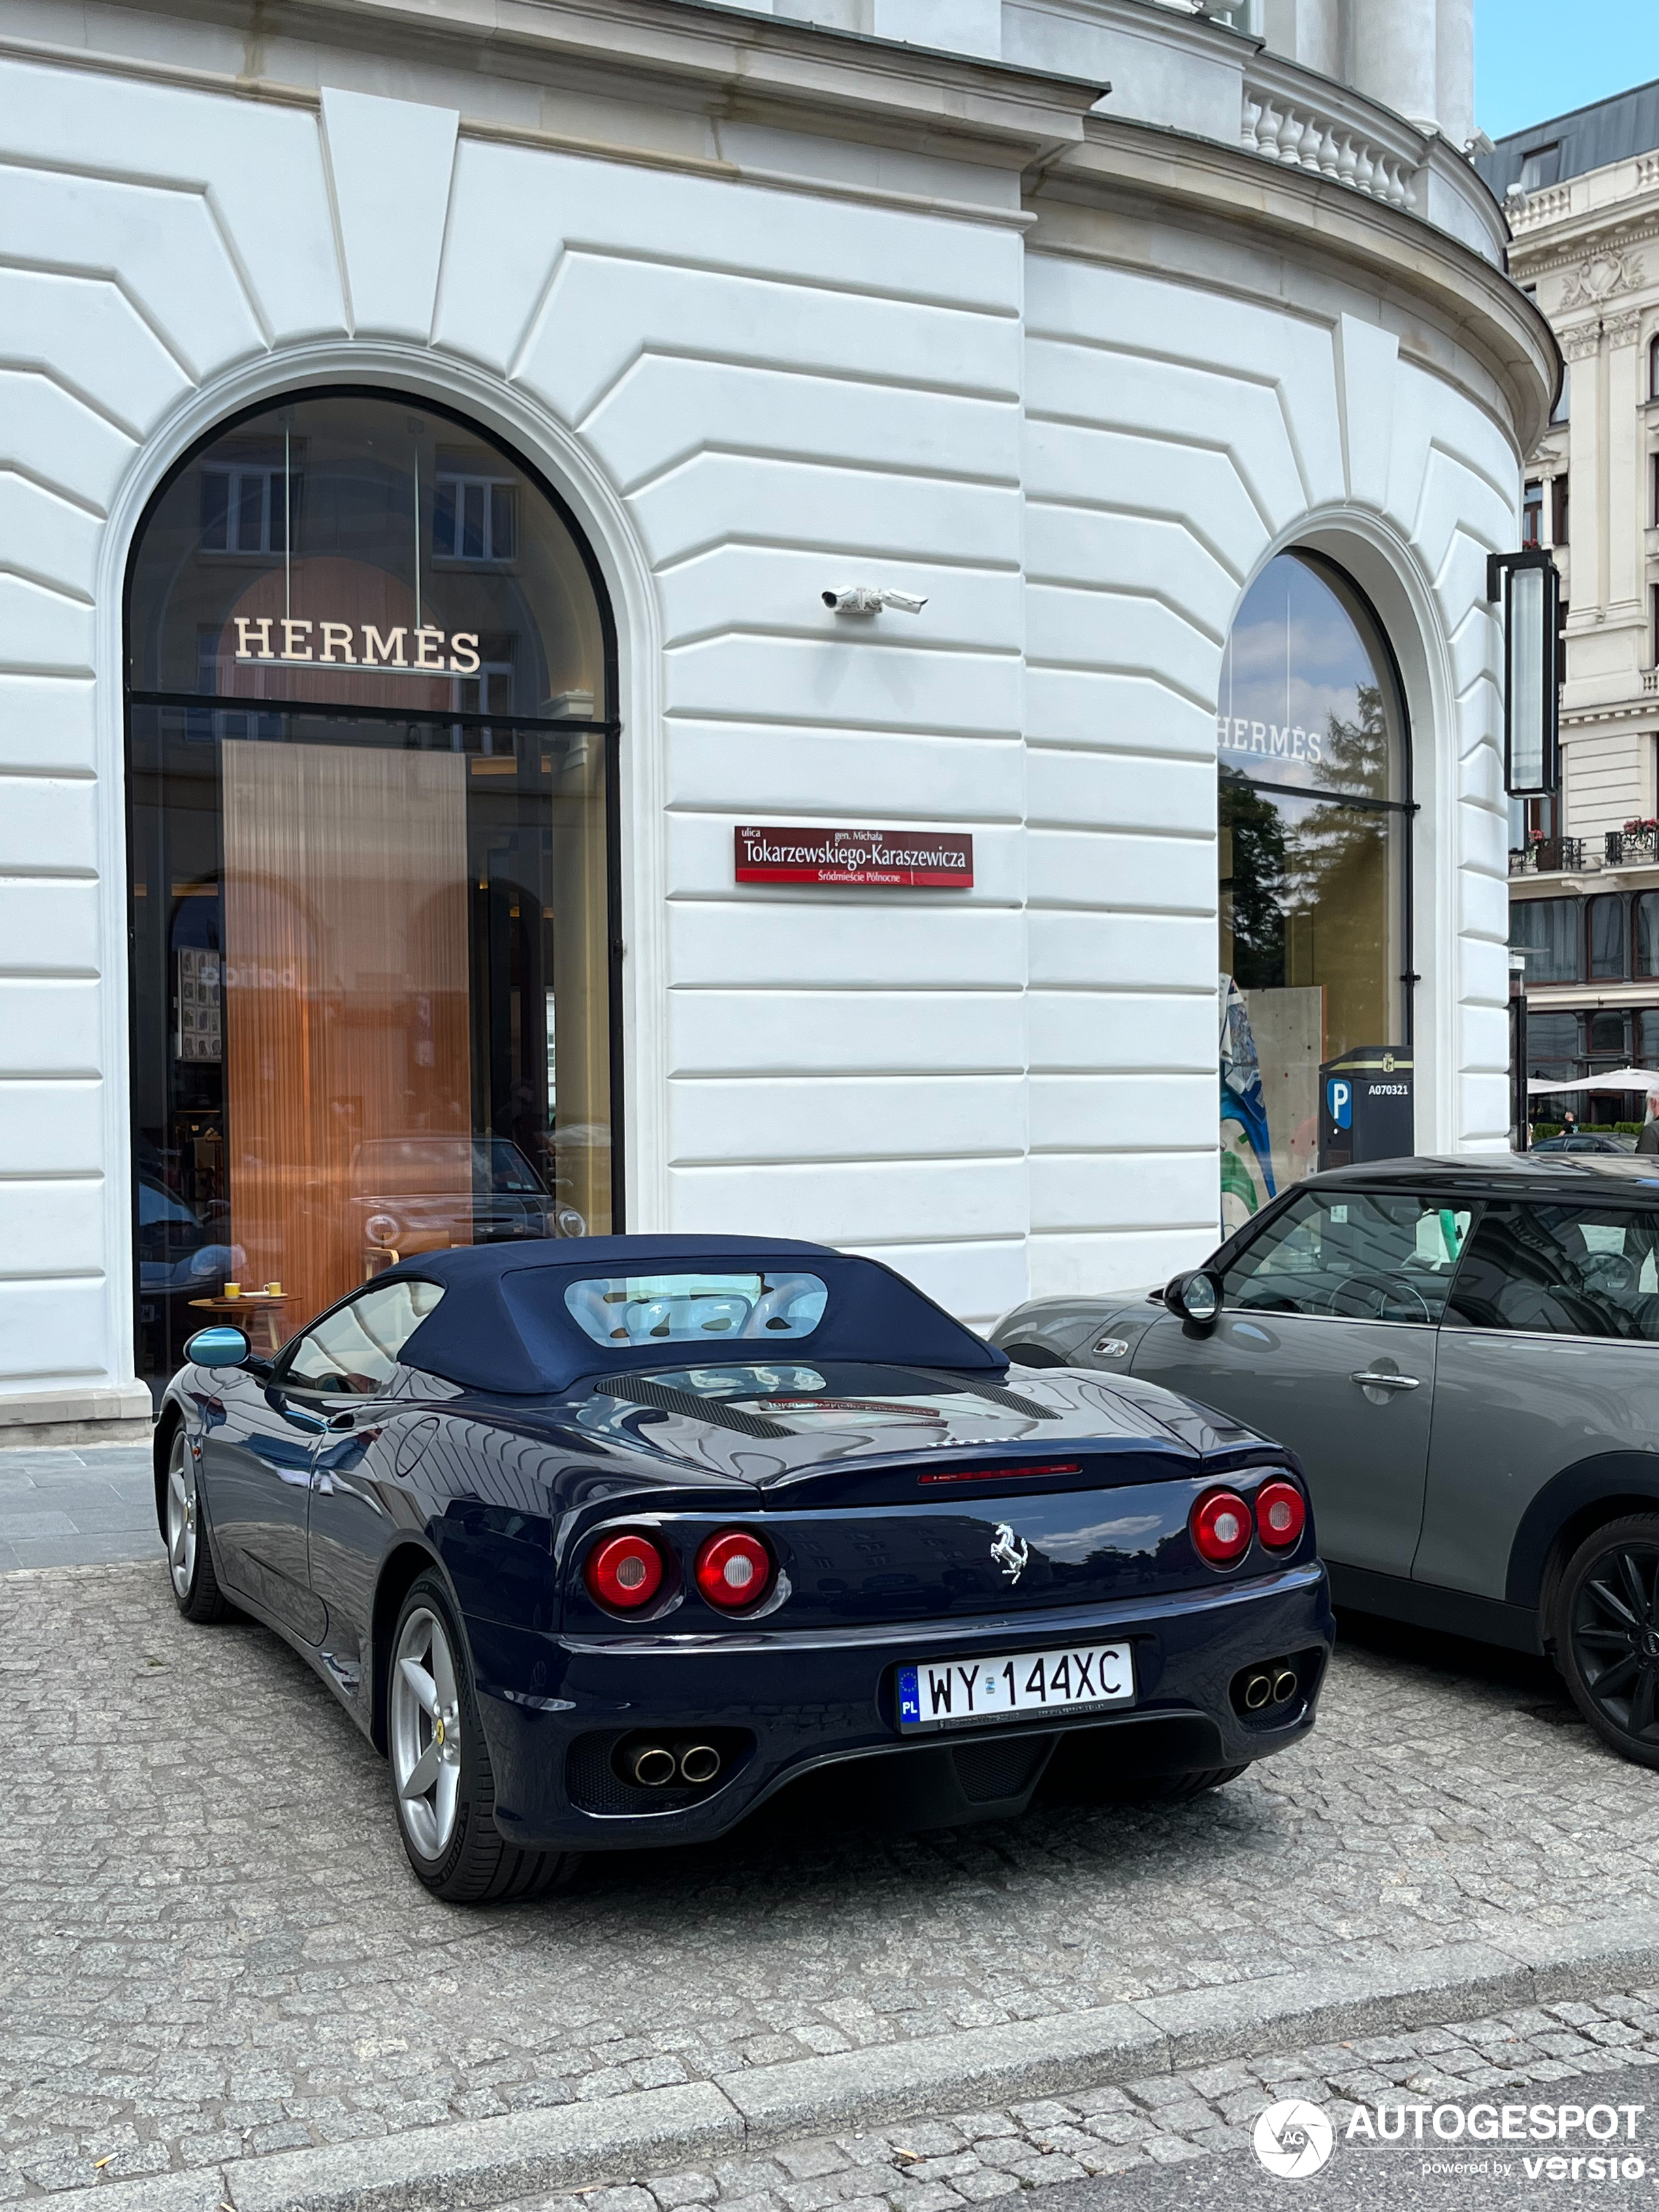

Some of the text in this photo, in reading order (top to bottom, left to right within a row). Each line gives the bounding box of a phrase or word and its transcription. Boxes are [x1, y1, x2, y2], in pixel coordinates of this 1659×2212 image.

[234, 617, 481, 674] HERMÈS
[741, 827, 761, 838] ulica
[834, 831, 883, 843] gen. Michała
[743, 839, 966, 871] Tokarzewskiego-Karaszewicza
[818, 869, 901, 883] Śródmieście Północne
[1368, 1084, 1409, 1095] A070321
[1334, 1083, 1349, 1119] P
[927, 1650, 1122, 1715] WY 144XC
[902, 1701, 918, 1715] PL
